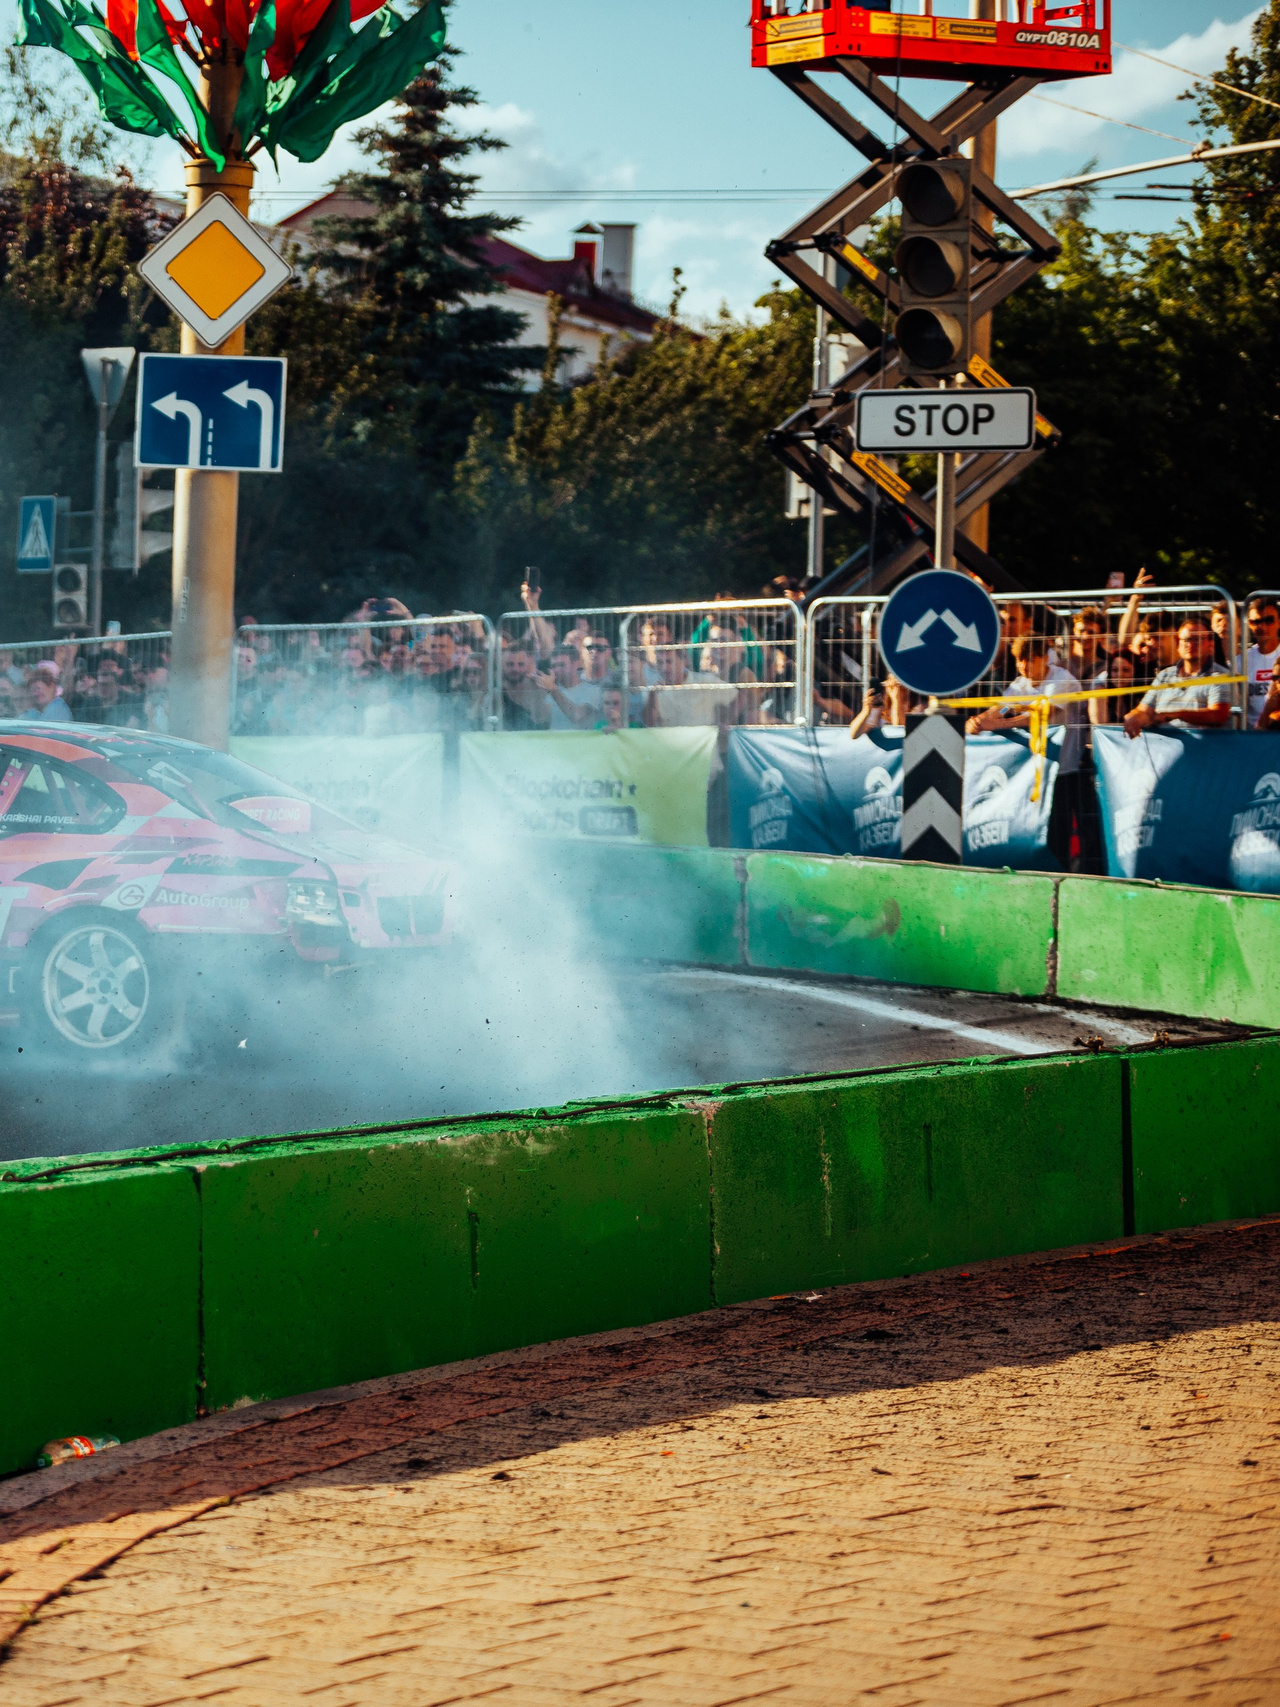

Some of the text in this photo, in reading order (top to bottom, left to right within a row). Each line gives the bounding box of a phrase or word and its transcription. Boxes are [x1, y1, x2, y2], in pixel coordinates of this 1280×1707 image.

[893, 403, 995, 436] STOP
[43, 814, 75, 824] PAVEL
[156, 888, 250, 912] AutoGroup
